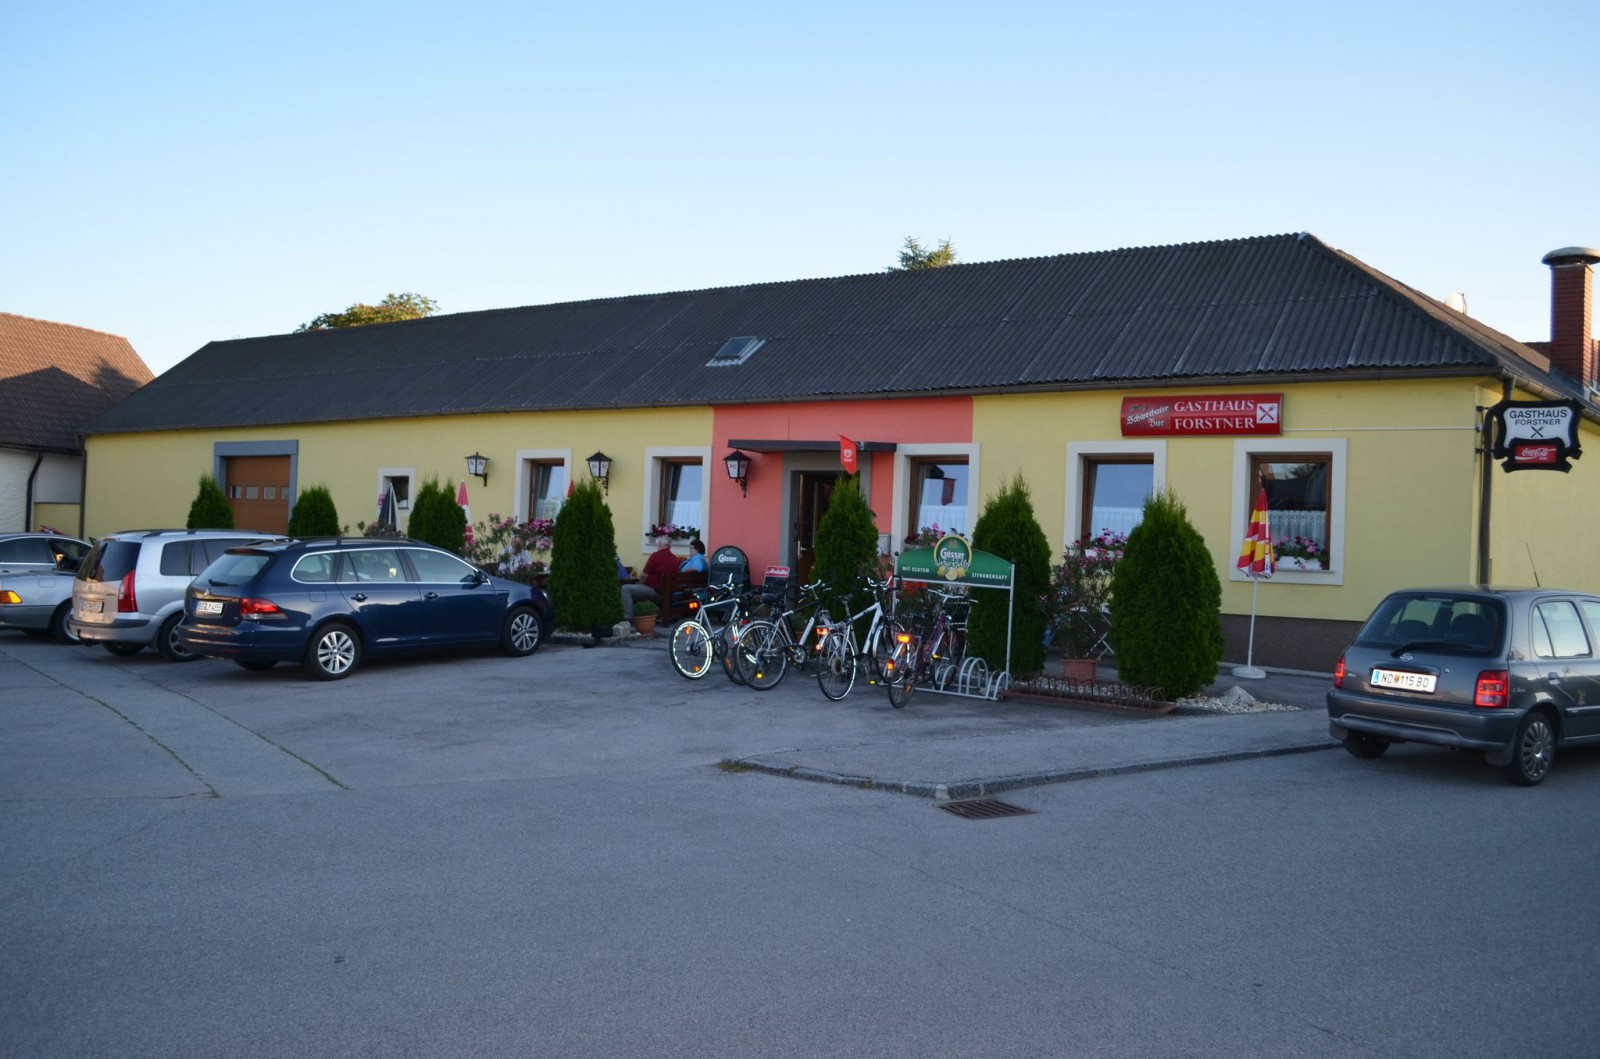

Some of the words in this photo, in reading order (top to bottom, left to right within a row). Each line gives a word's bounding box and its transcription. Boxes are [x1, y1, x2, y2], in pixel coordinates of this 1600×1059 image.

[1174, 399, 1255, 413] GASTHAUS
[1509, 409, 1568, 419] GASTHAUS
[1147, 416, 1165, 428] Bier
[1174, 417, 1255, 430] FORSTNER
[1514, 418, 1561, 426] FORSTNER
[1382, 673, 1394, 684] ND
[1400, 675, 1414, 687] 115
